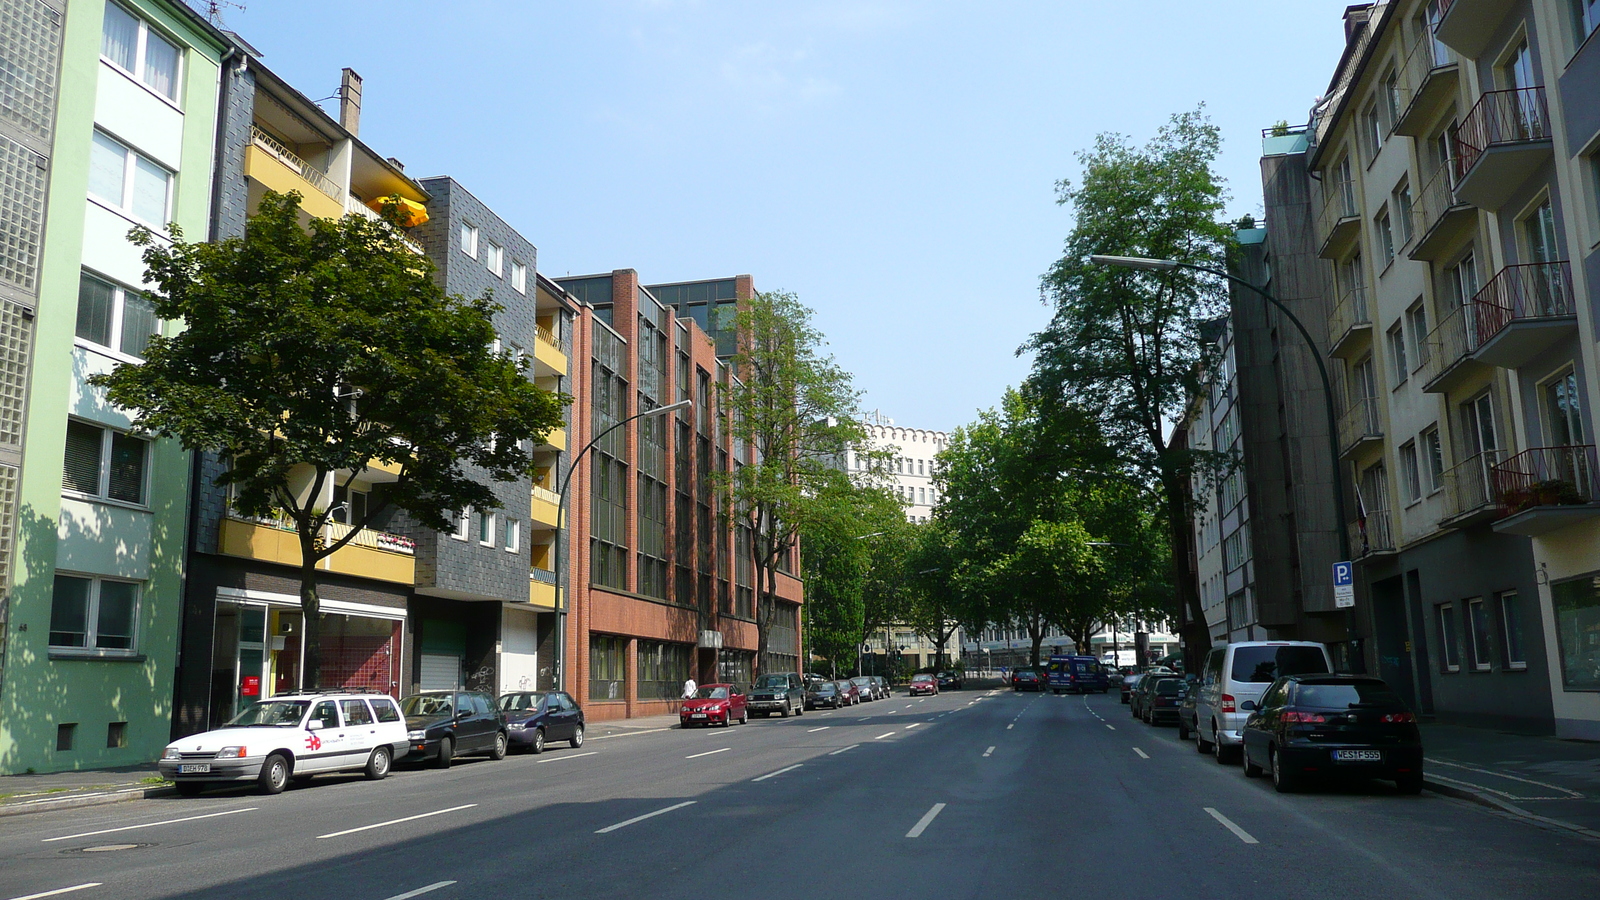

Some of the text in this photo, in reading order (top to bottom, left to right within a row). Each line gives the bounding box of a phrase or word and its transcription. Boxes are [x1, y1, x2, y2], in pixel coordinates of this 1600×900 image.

[1337, 565, 1348, 583] P
[1337, 750, 1354, 759] WES
[1364, 750, 1380, 759] 555
